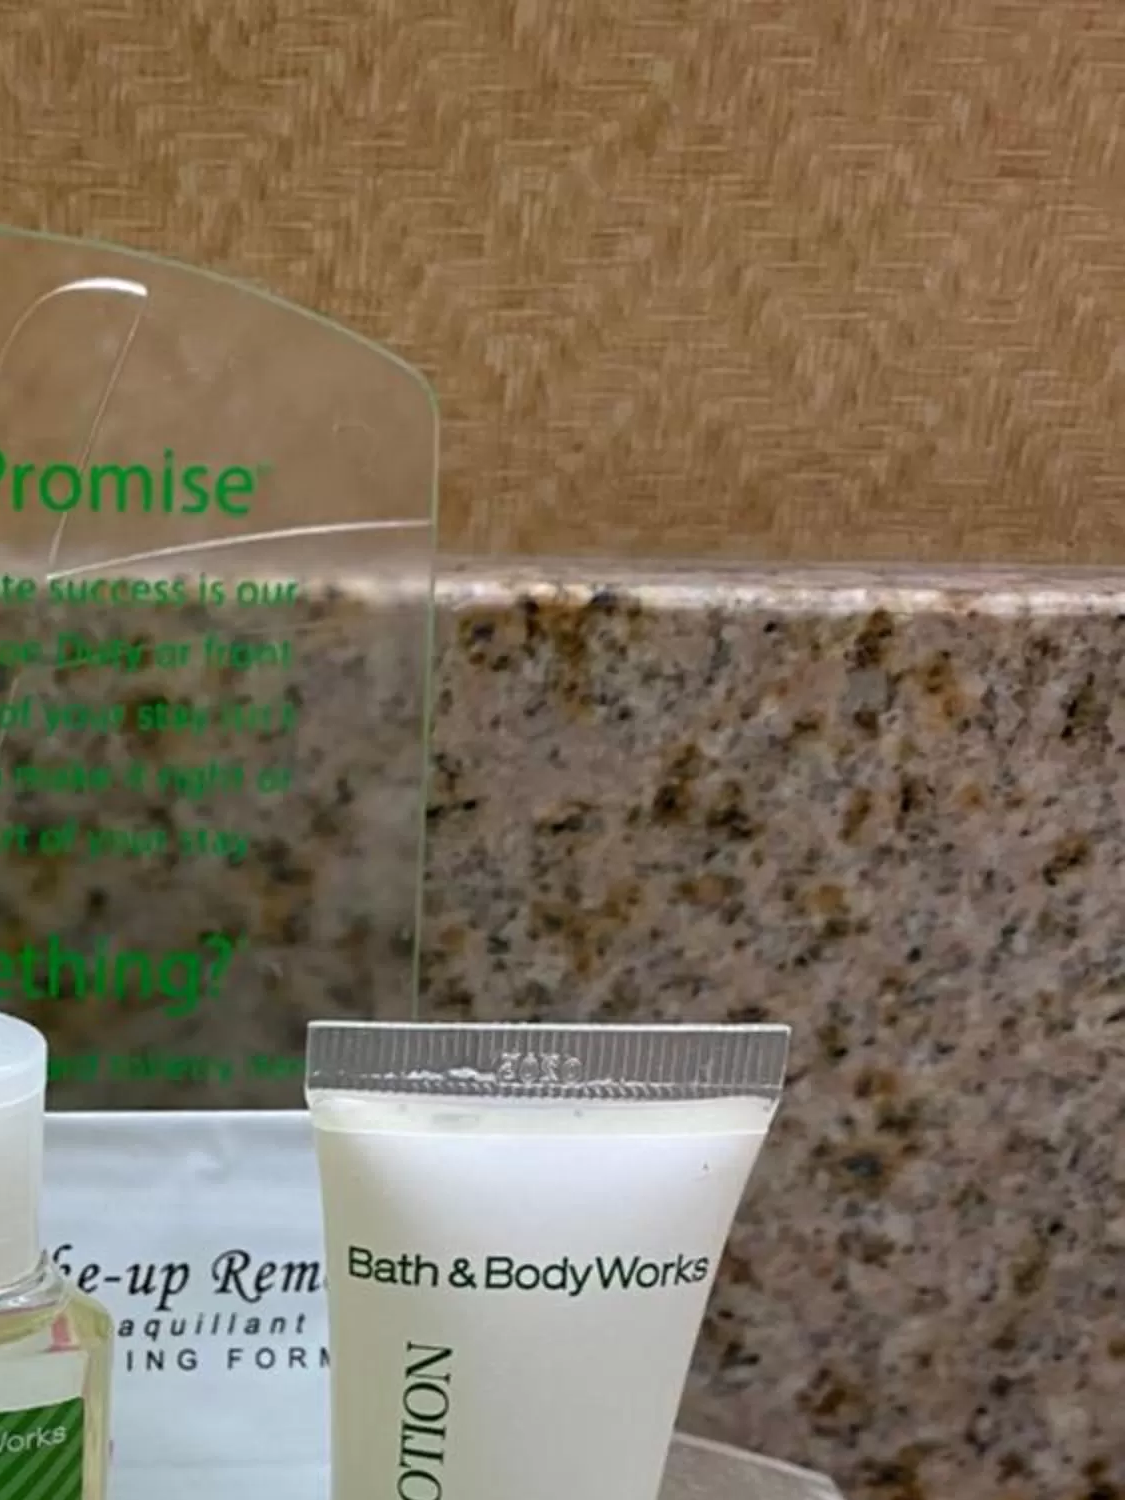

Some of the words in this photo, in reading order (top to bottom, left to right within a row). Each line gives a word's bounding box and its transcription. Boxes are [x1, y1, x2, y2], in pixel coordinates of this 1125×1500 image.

[47, 575, 186, 606] success
[199, 572, 225, 606] is
[236, 578, 298, 606] our
[55, 630, 149, 674] Duty
[155, 640, 191, 668] or
[203, 630, 294, 670] front
[45, 704, 125, 736] your
[136, 700, 210, 736] stay
[37, 818, 77, 856] of
[211, 1249, 329, 1305] Rem
[347, 1245, 439, 1289] Bath
[448, 1257, 477, 1290] &
